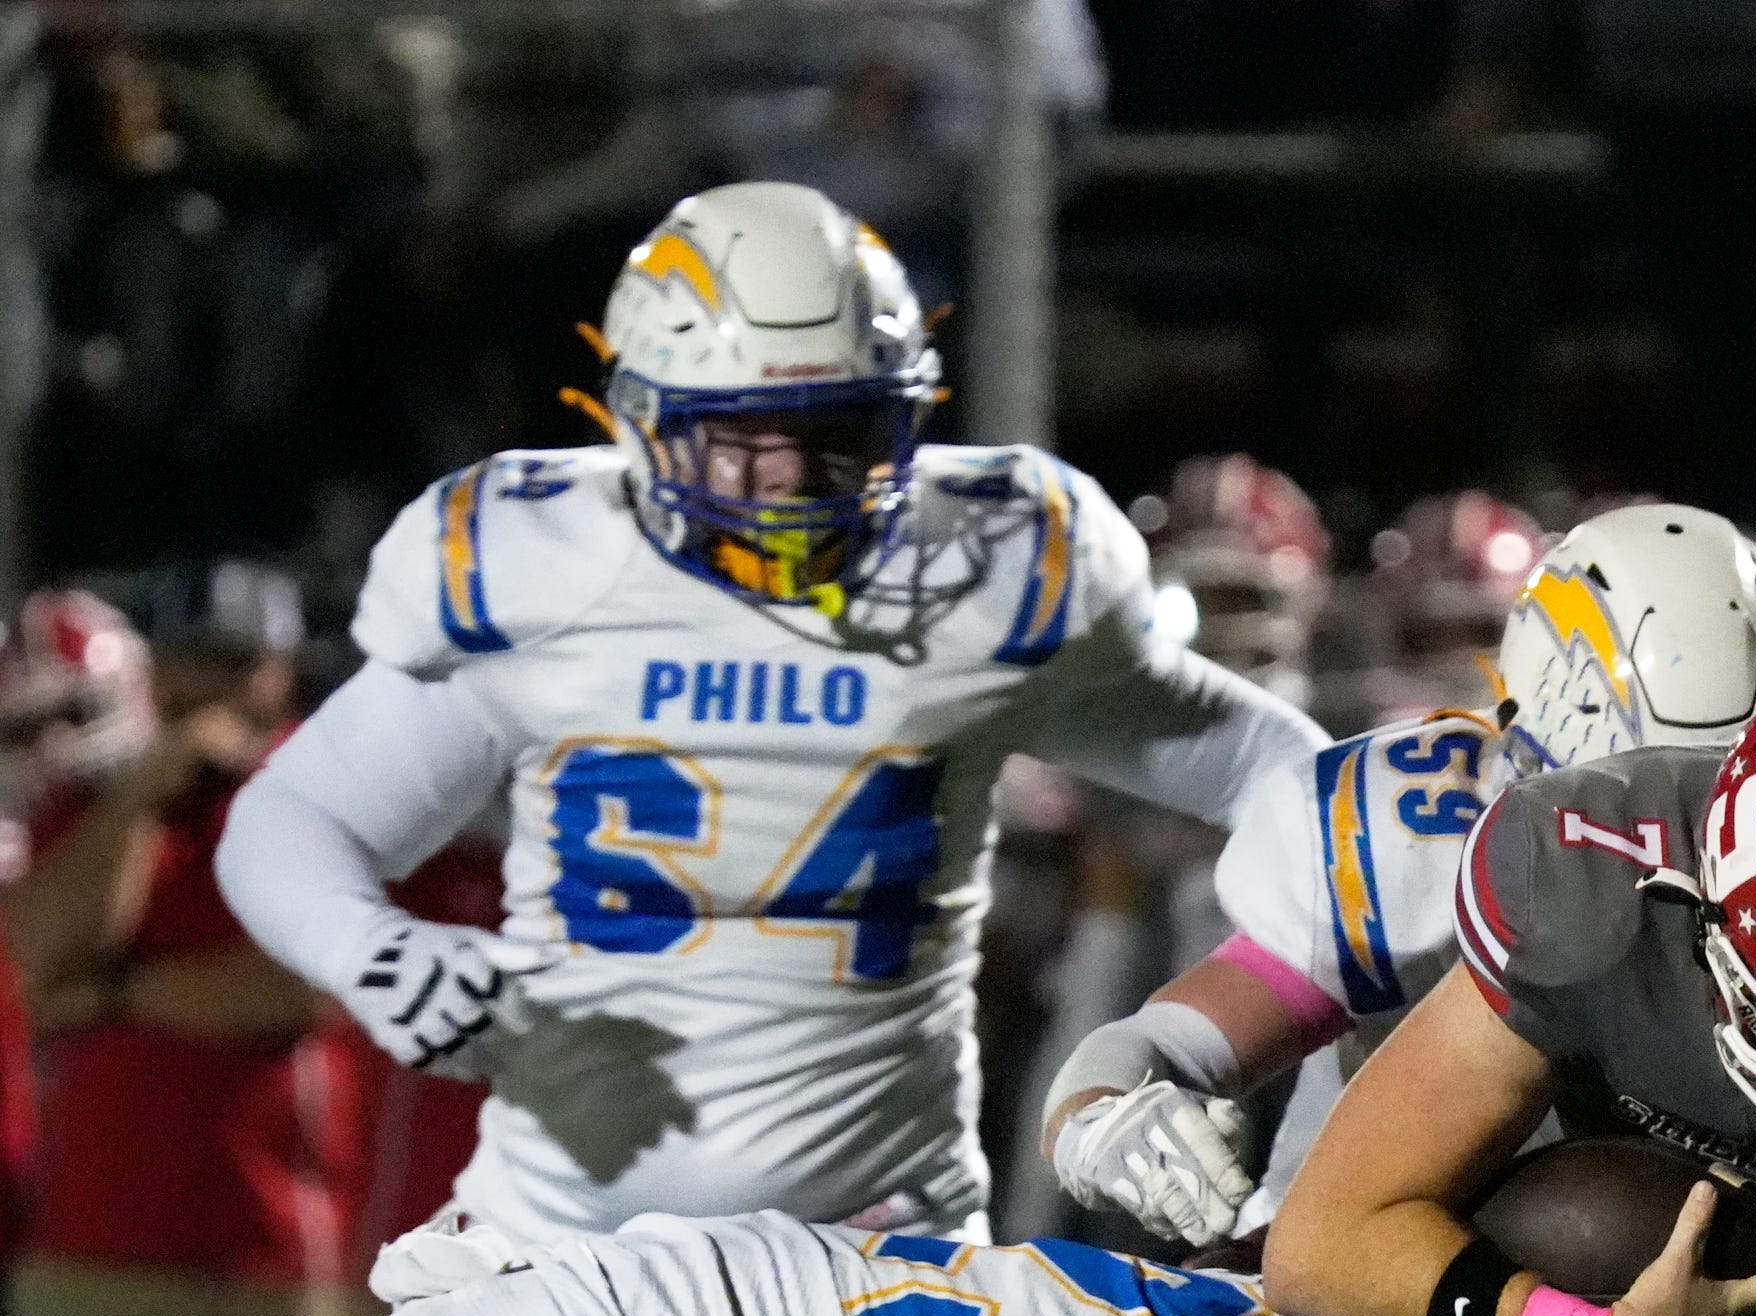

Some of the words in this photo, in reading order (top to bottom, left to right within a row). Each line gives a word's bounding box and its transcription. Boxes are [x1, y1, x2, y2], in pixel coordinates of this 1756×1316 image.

[639, 657, 870, 727] PHILO
[1384, 726, 1488, 842] 59
[540, 736, 948, 985] 64
[1555, 806, 1668, 870] 7
